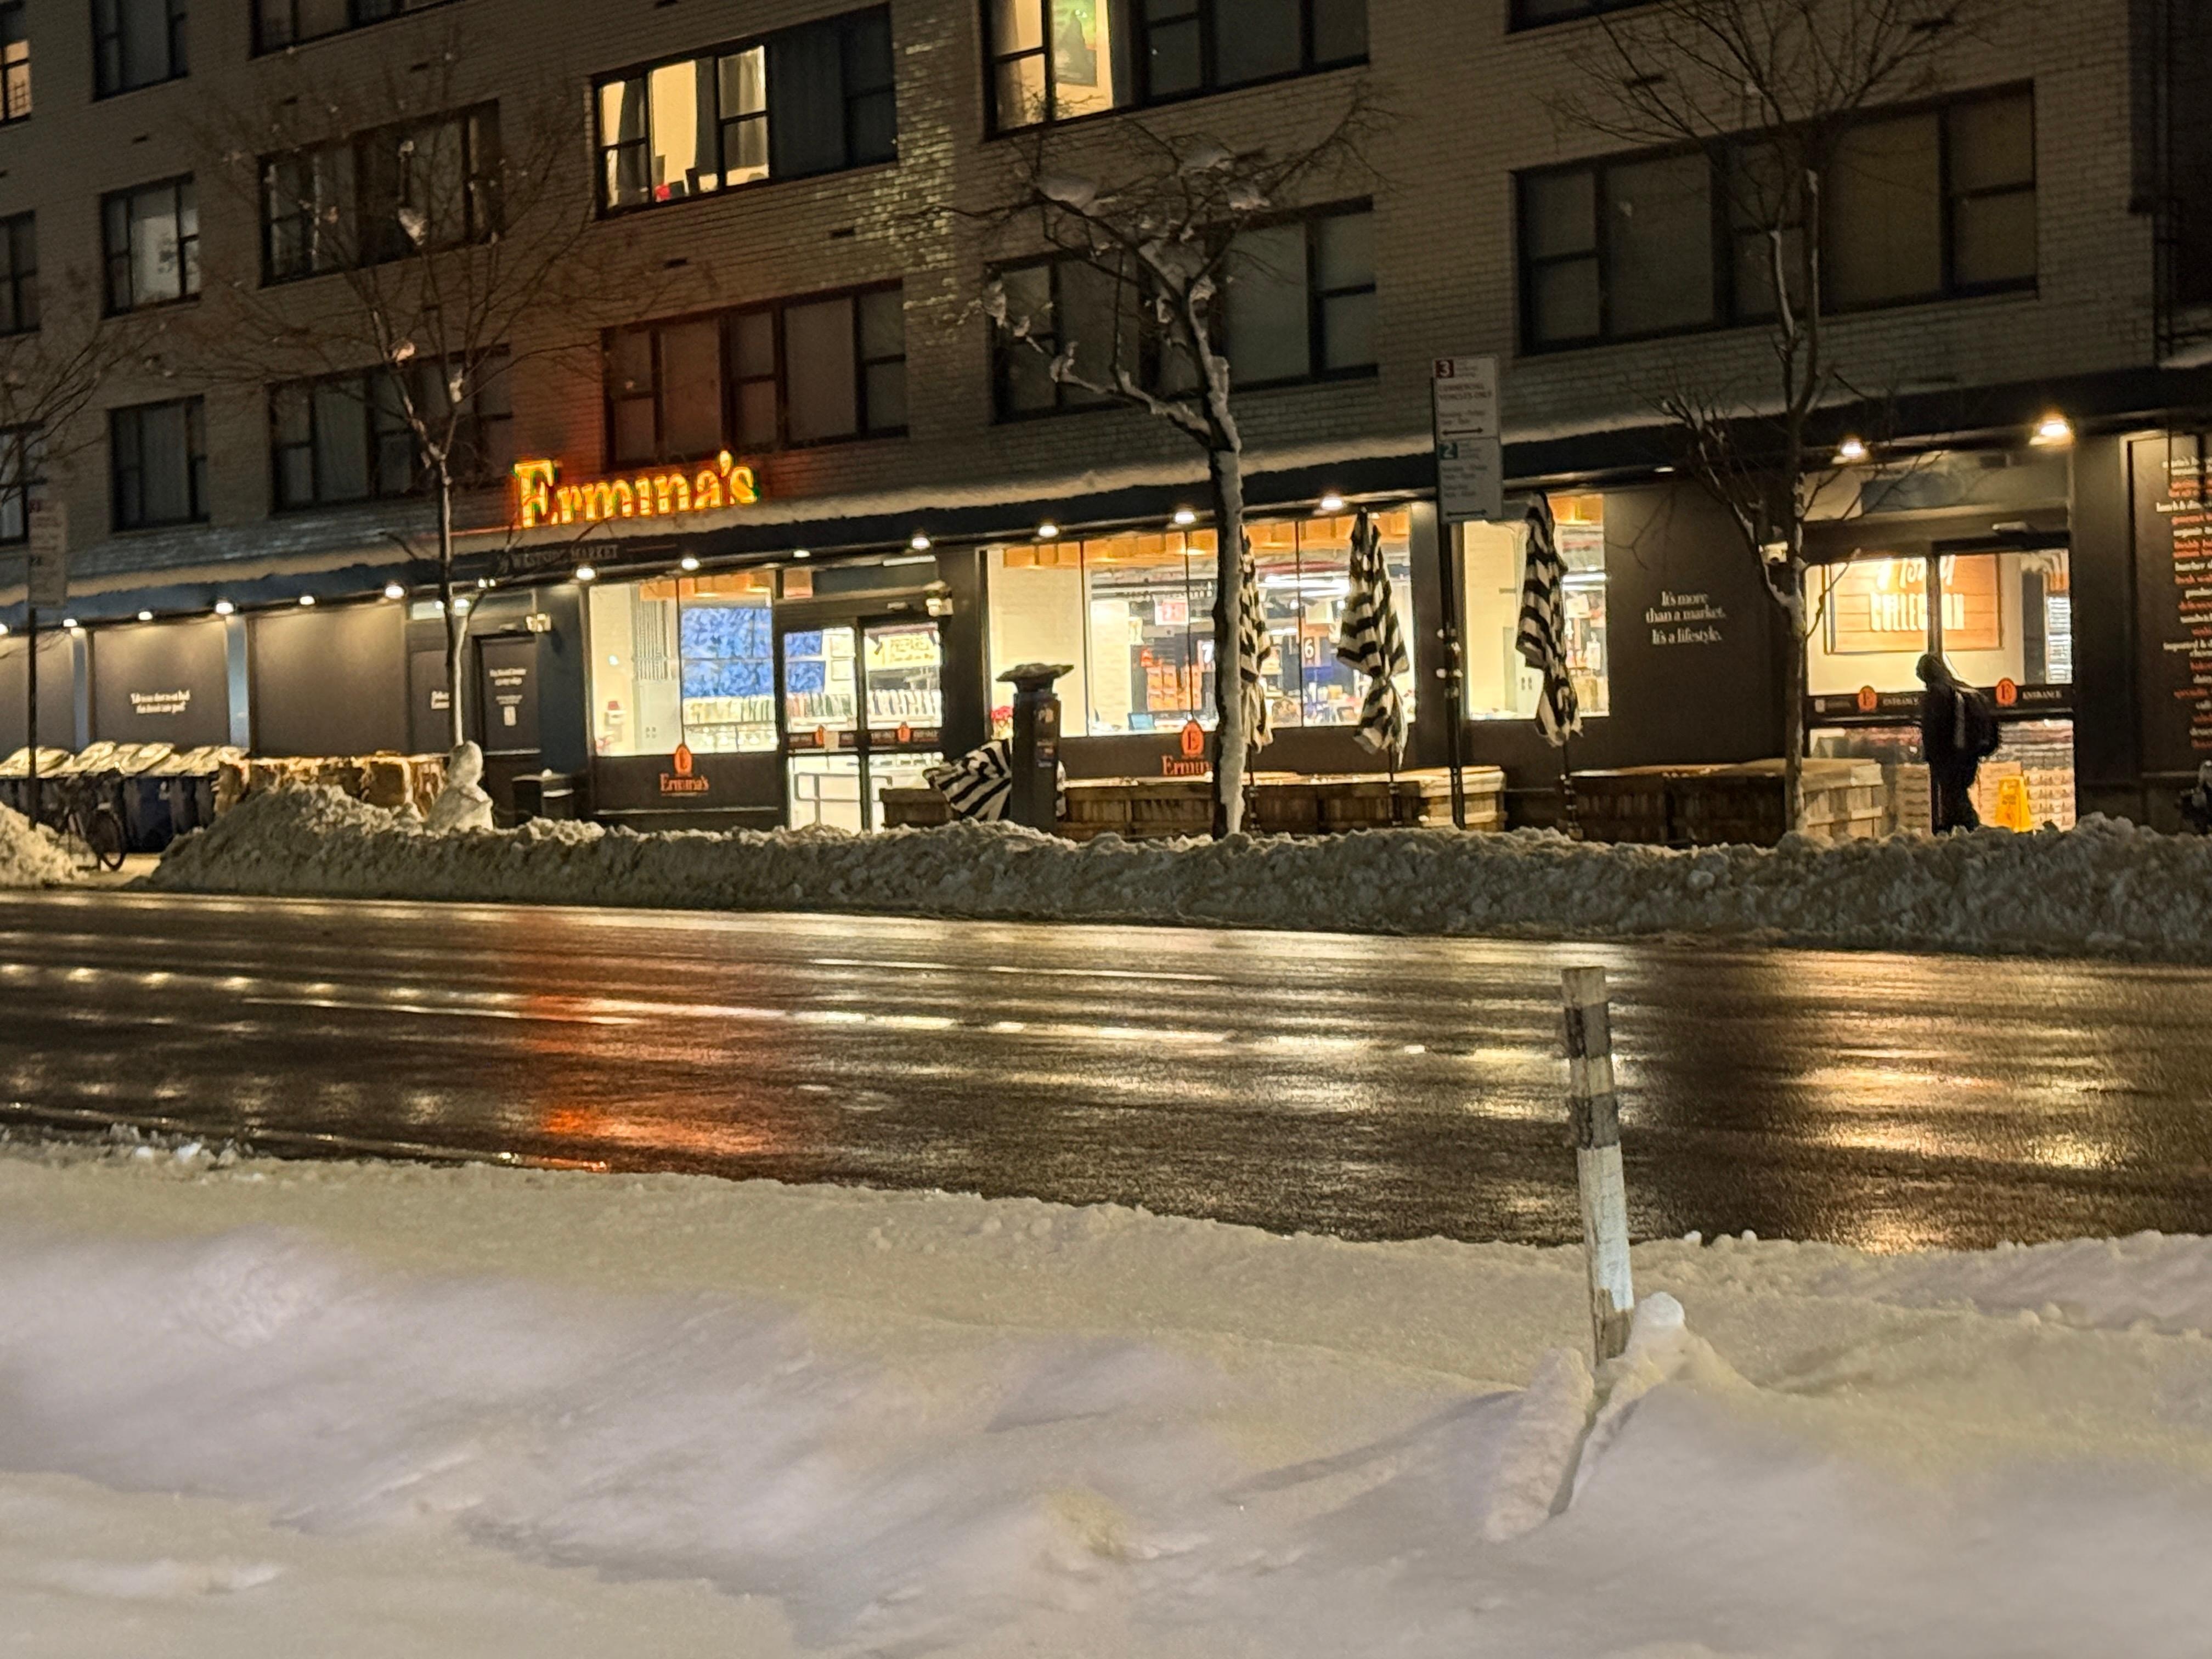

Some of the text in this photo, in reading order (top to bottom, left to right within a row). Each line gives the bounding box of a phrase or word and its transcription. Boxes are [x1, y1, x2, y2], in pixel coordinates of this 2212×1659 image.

[1438, 361, 1451, 377] 3
[1442, 443, 1454, 458] 2
[1678, 594, 1709, 605] more
[1646, 607, 1672, 623] than
[1674, 611, 1680, 621] a
[1668, 633, 1675, 644] a
[1201, 644, 1213, 663] 7
[1304, 638, 1314, 658] 6
